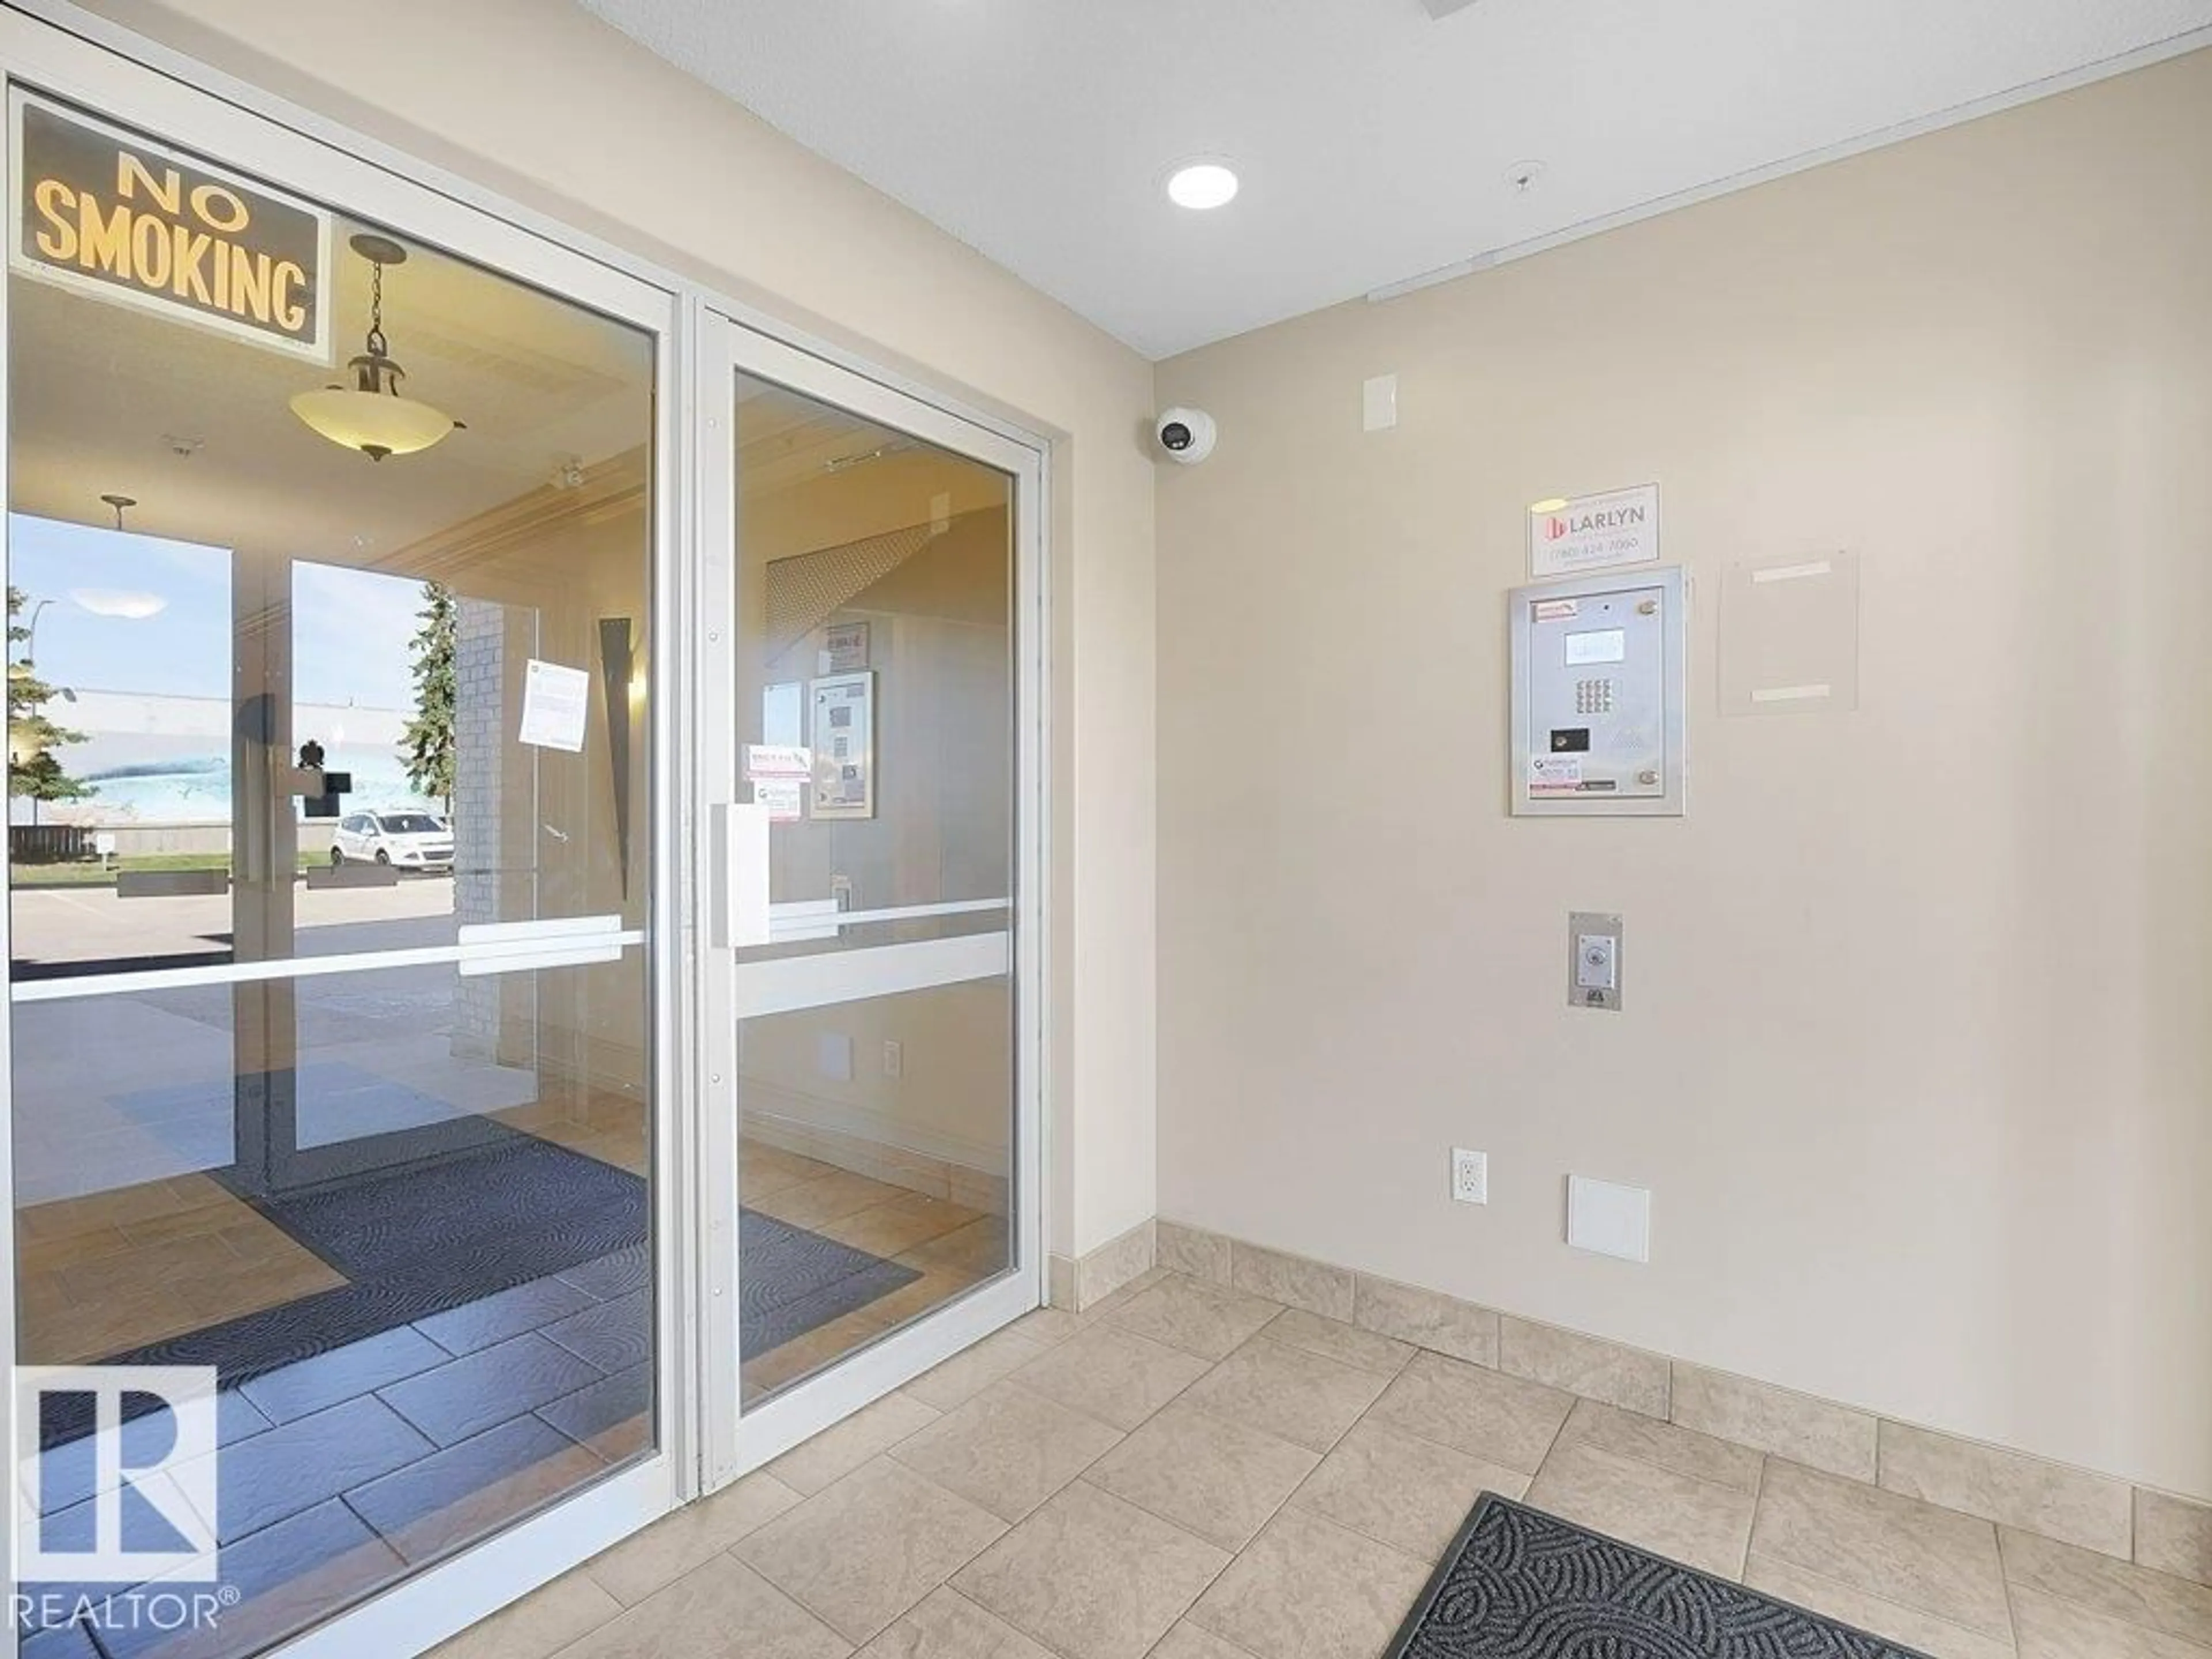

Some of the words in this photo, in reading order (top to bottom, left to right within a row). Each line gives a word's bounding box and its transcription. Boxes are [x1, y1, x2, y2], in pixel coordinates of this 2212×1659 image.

[119, 150, 249, 232] NO
[35, 179, 305, 331] SMOKING
[1570, 506, 1645, 533] LARLYN
